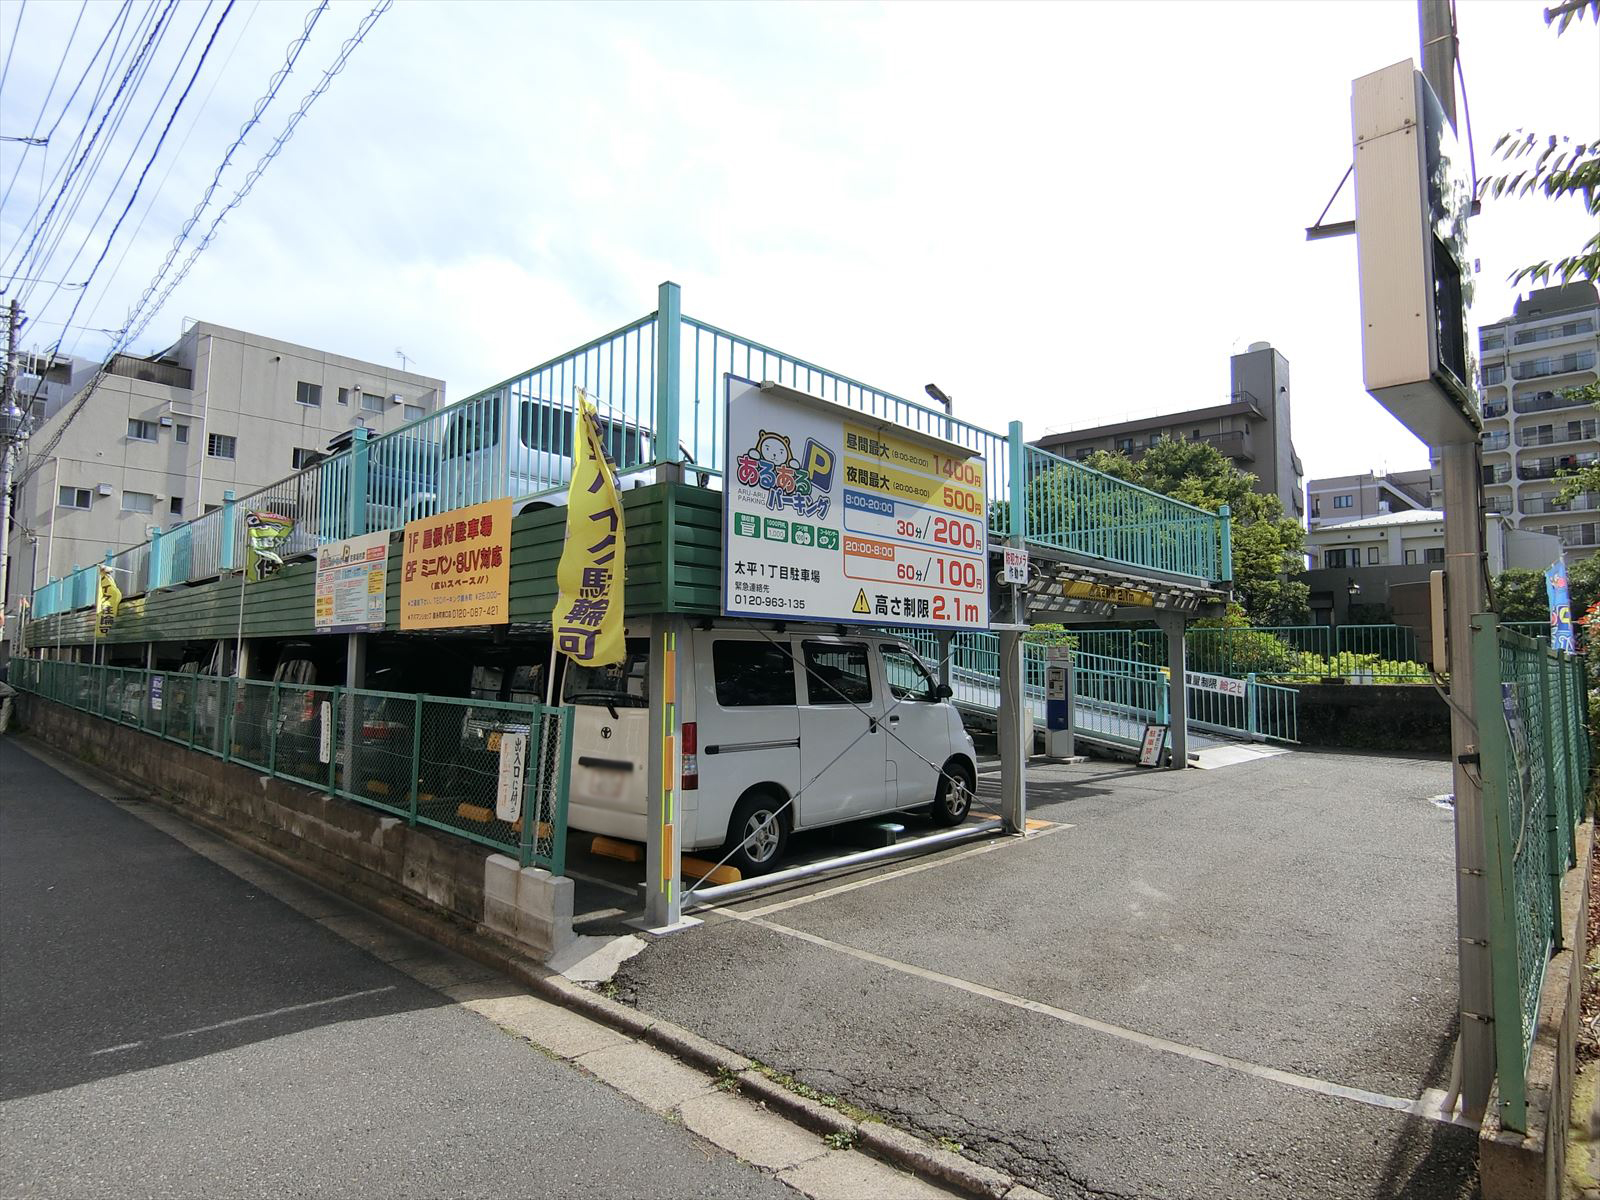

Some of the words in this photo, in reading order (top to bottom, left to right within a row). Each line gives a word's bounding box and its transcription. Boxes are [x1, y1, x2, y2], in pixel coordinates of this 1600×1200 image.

[808, 444, 832, 480] P
[846, 432, 890, 459] 昼間最大
[891, 449, 929, 468] (8:00-20:00)
[933, 454, 982, 487] 1400円
[738, 455, 812, 495] あるある
[737, 488, 766, 499] ARU-ARU
[737, 495, 766, 506] PARKING
[846, 466, 890, 491] 夜間最大
[893, 481, 930, 499] (20:00-8:00)
[943, 487, 982, 515] 500円
[767, 487, 831, 520] パーキング
[845, 494, 893, 513] 8:00-20:00
[408, 532, 419, 553] 1F
[422, 515, 493, 550] 屋根付駐車場
[845, 541, 893, 557] 20:00-8:00
[1005, 551, 1027, 566] 防犯カメラ
[405, 560, 417, 582] 2F
[734, 561, 820, 584] 太平1丁目駐車場
[734, 581, 770, 594] 緊急連絡先
[452, 605, 499, 619] 0120-087-421
[734, 594, 806, 610] 0120-963-135
